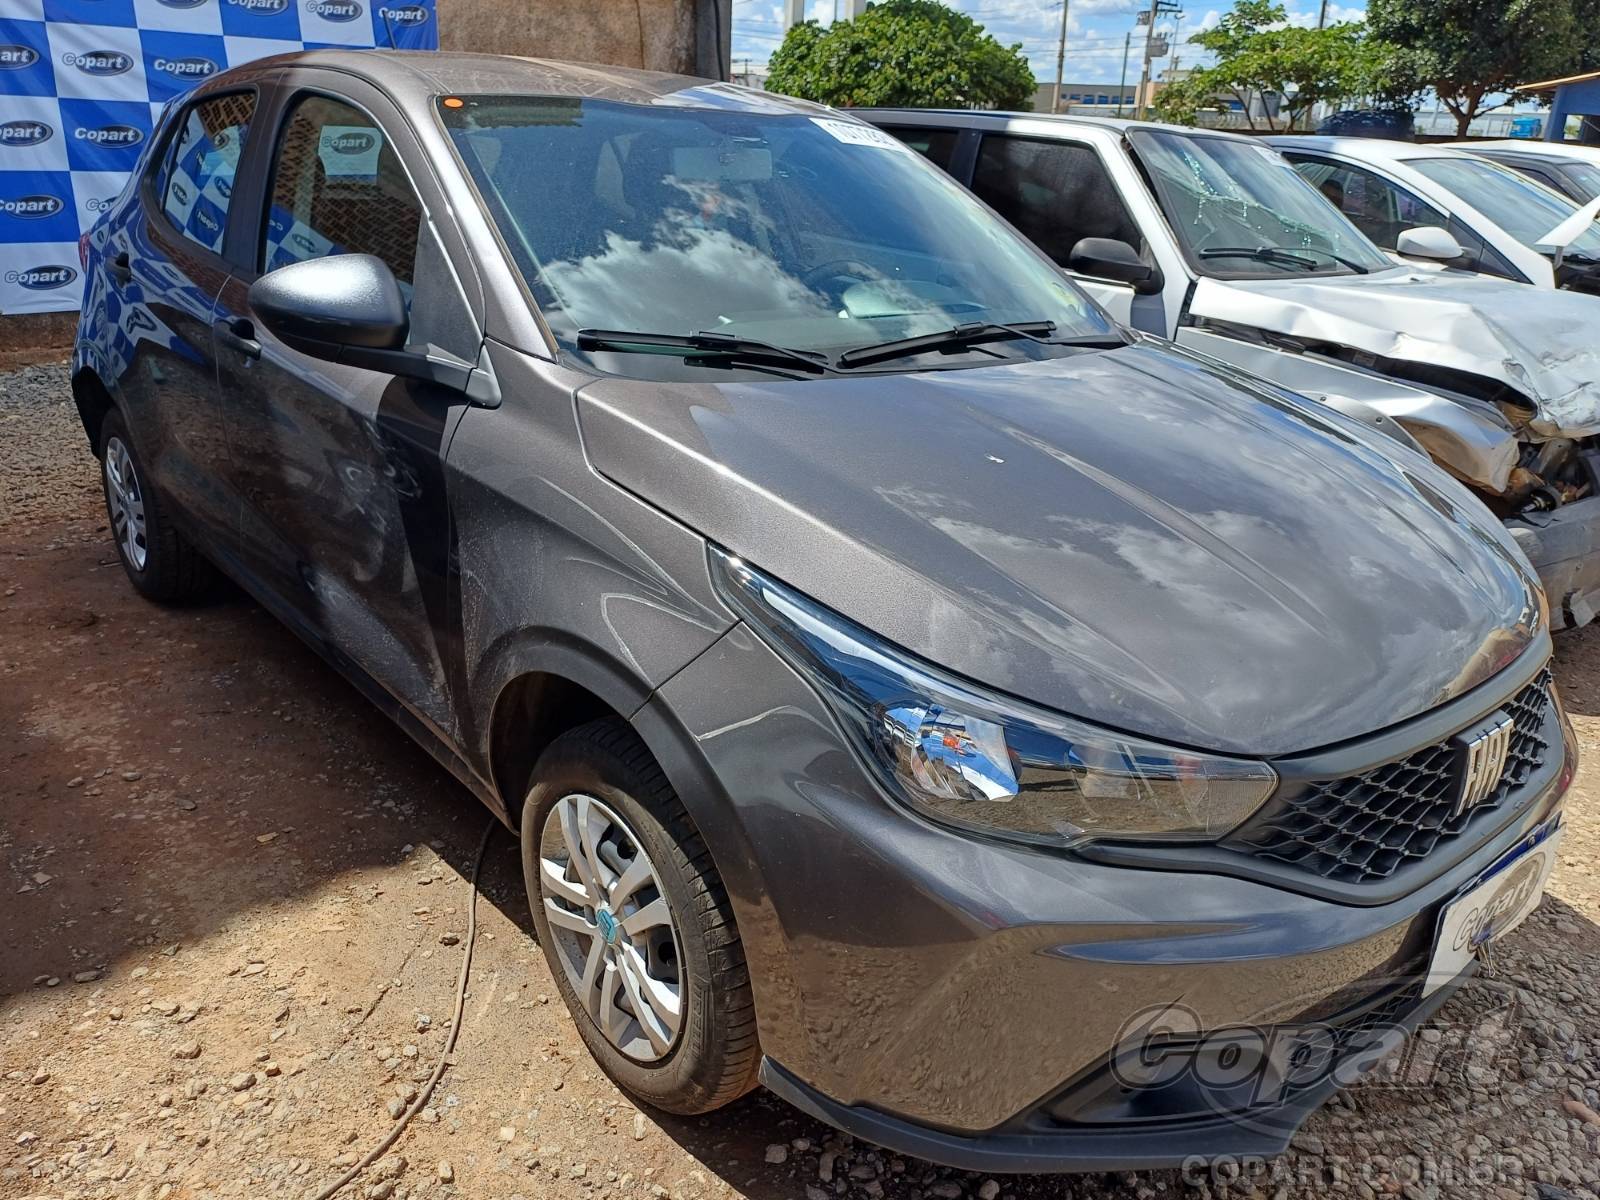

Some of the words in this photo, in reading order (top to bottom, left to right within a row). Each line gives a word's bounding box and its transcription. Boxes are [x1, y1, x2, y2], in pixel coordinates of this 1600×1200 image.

[306, 2, 355, 15] Copart
[379, 7, 424, 21] Copart
[62, 53, 124, 69] Copart
[154, 59, 211, 74] Copart
[0, 126, 42, 139] part
[74, 127, 136, 142] Copart
[322, 135, 369, 149] Copart
[5, 270, 67, 284] Copart
